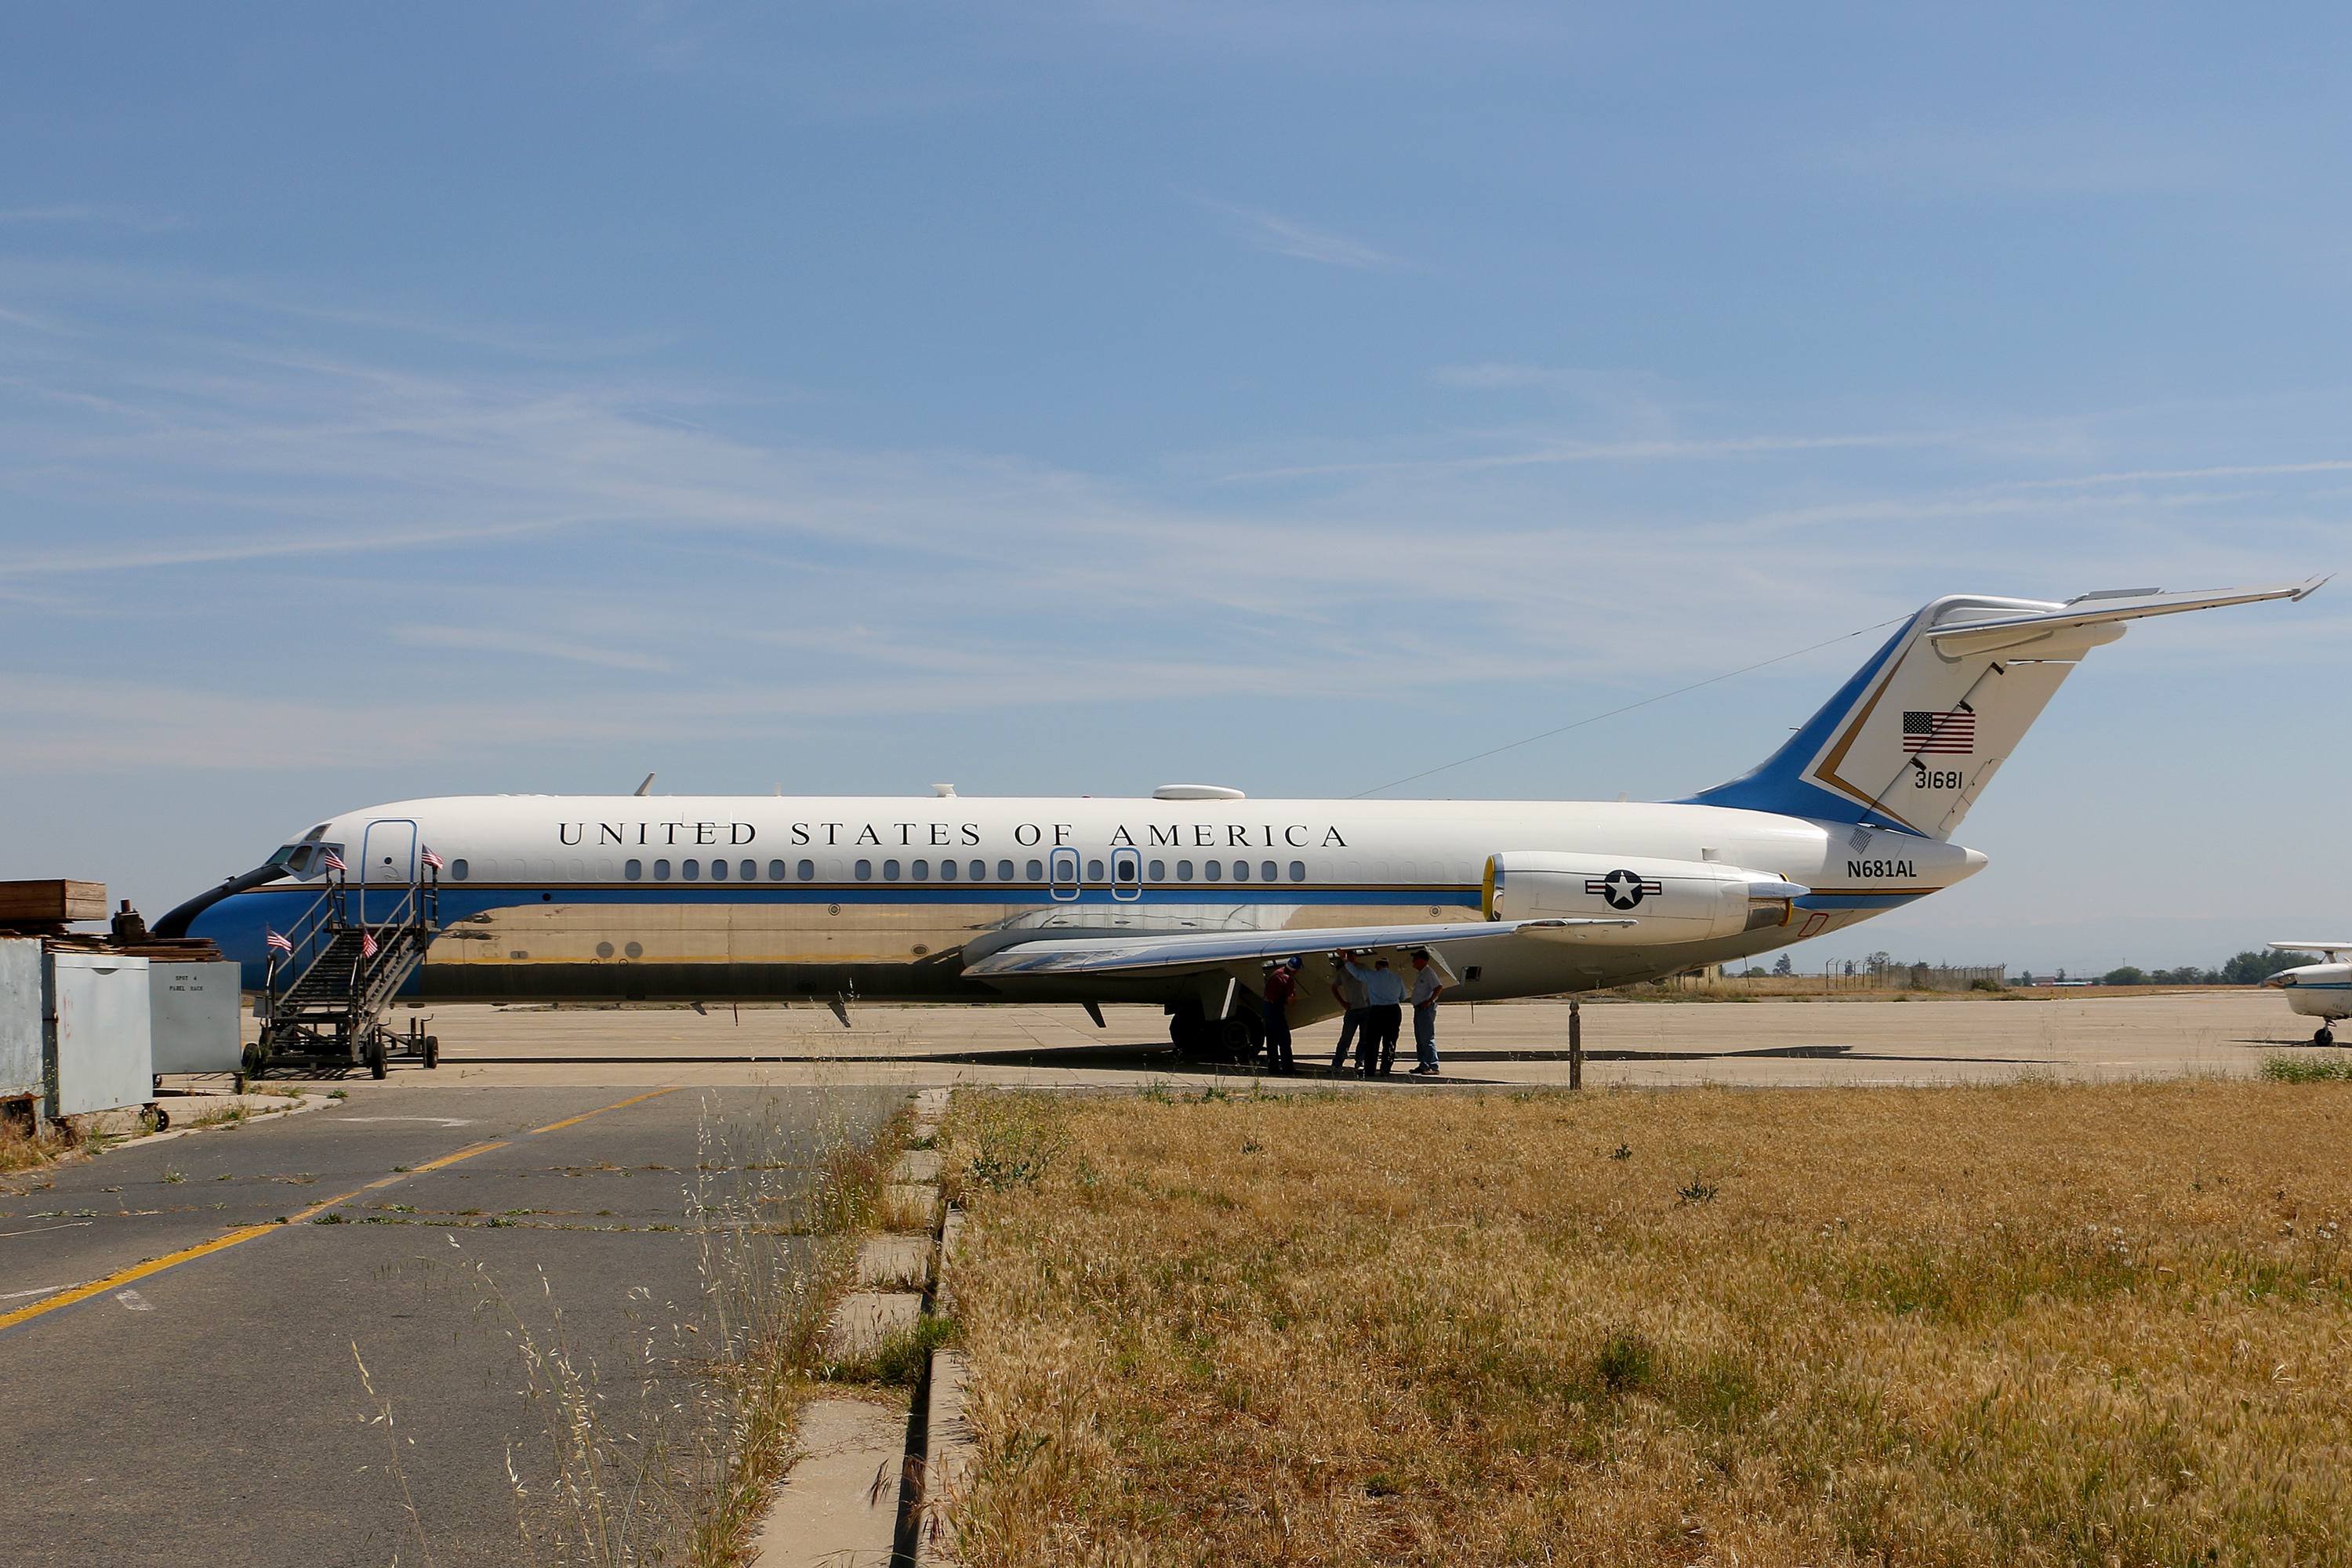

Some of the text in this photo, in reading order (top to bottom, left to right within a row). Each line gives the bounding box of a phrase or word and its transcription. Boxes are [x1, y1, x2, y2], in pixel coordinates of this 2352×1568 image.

[1915, 771, 1963, 789] 31681
[557, 822, 1349, 848] UNITED STATES OF AMERICA
[1847, 859, 1918, 878] N681AL
